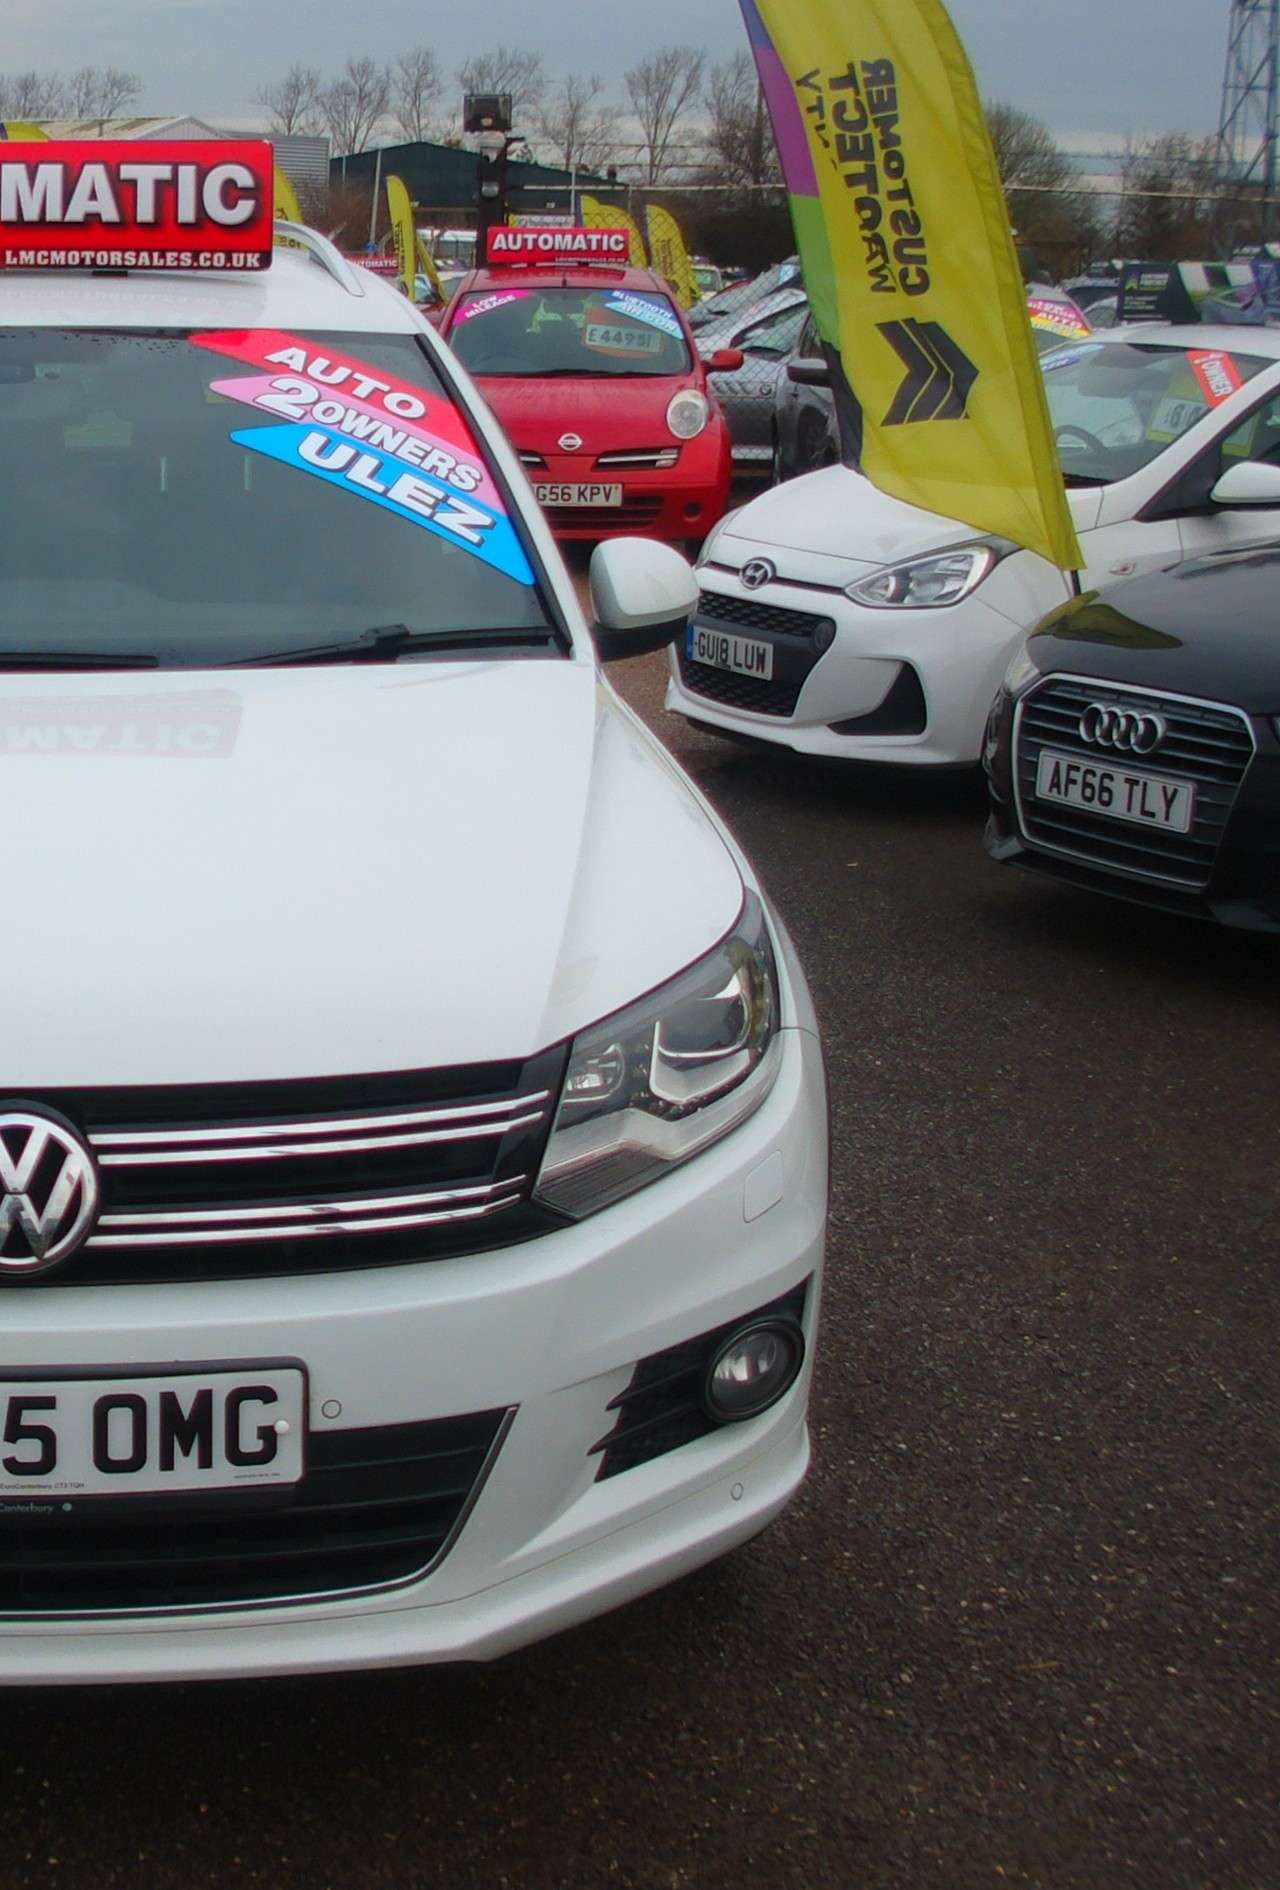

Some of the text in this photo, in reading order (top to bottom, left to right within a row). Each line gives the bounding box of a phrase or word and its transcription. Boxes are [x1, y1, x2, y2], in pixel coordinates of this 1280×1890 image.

[5, 249, 261, 268] LMCMOTORSALES.CO.UK
[491, 233, 625, 251] AUTOMATIC
[264, 347, 427, 420] AUTO
[296, 431, 497, 547] ULEZ
[576, 485, 614, 503] KPV
[1048, 760, 1180, 822] AF66 TLY
[92, 1383, 281, 1474] OMG
